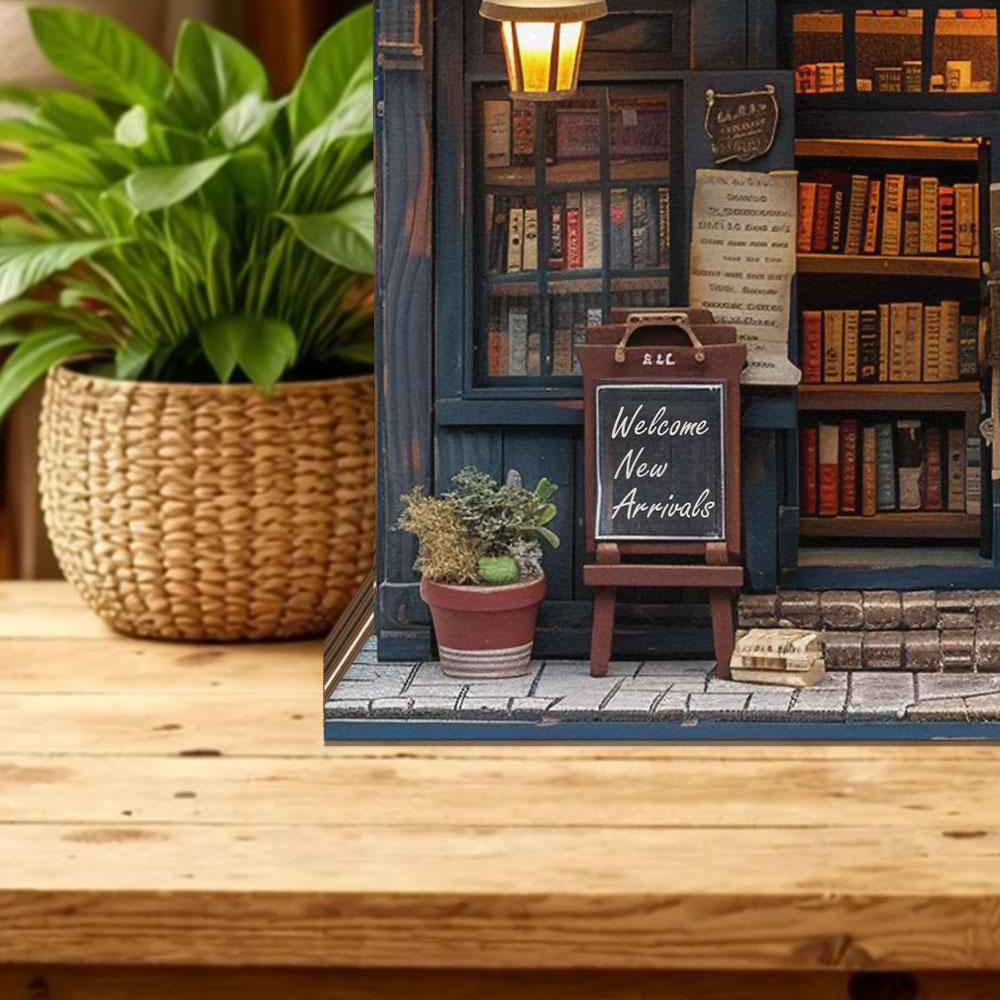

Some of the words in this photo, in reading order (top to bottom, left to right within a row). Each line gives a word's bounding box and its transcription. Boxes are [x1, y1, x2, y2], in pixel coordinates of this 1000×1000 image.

[611, 404, 710, 439] Welcome
[614, 446, 669, 480] New
[611, 487, 716, 520] Arrivals
